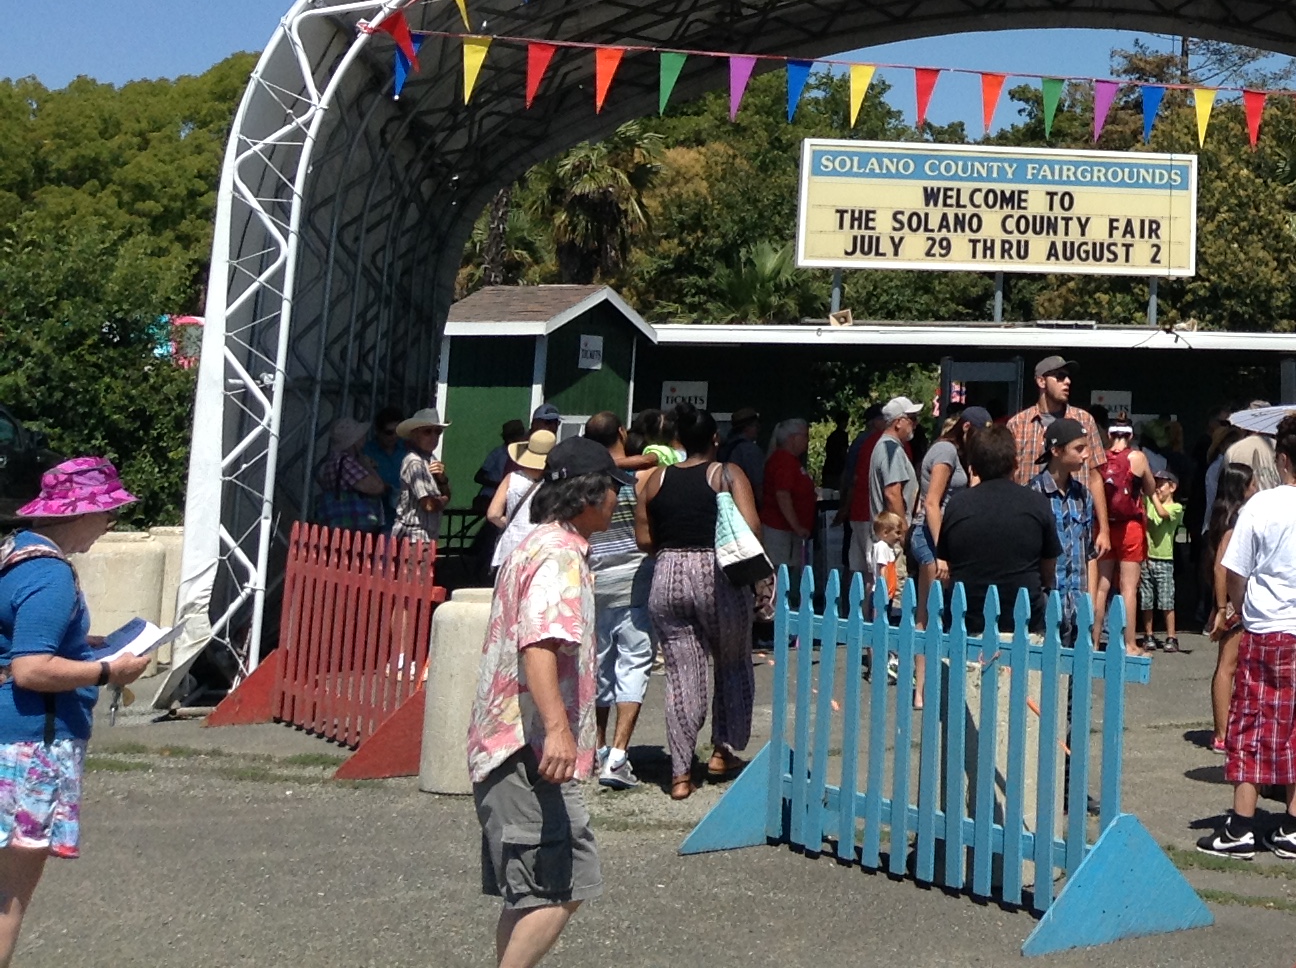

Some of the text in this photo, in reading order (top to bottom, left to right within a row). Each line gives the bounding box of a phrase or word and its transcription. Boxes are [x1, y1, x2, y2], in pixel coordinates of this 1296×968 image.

[820, 155, 1182, 185] SOLANO COUNTY FAIRGROUNDS
[922, 186, 1074, 212] WELCOME TO
[835, 210, 1161, 240] THE SOLANO COUNTY FAIR
[844, 235, 1161, 264] JULY 29 THRU AUGUST 2
